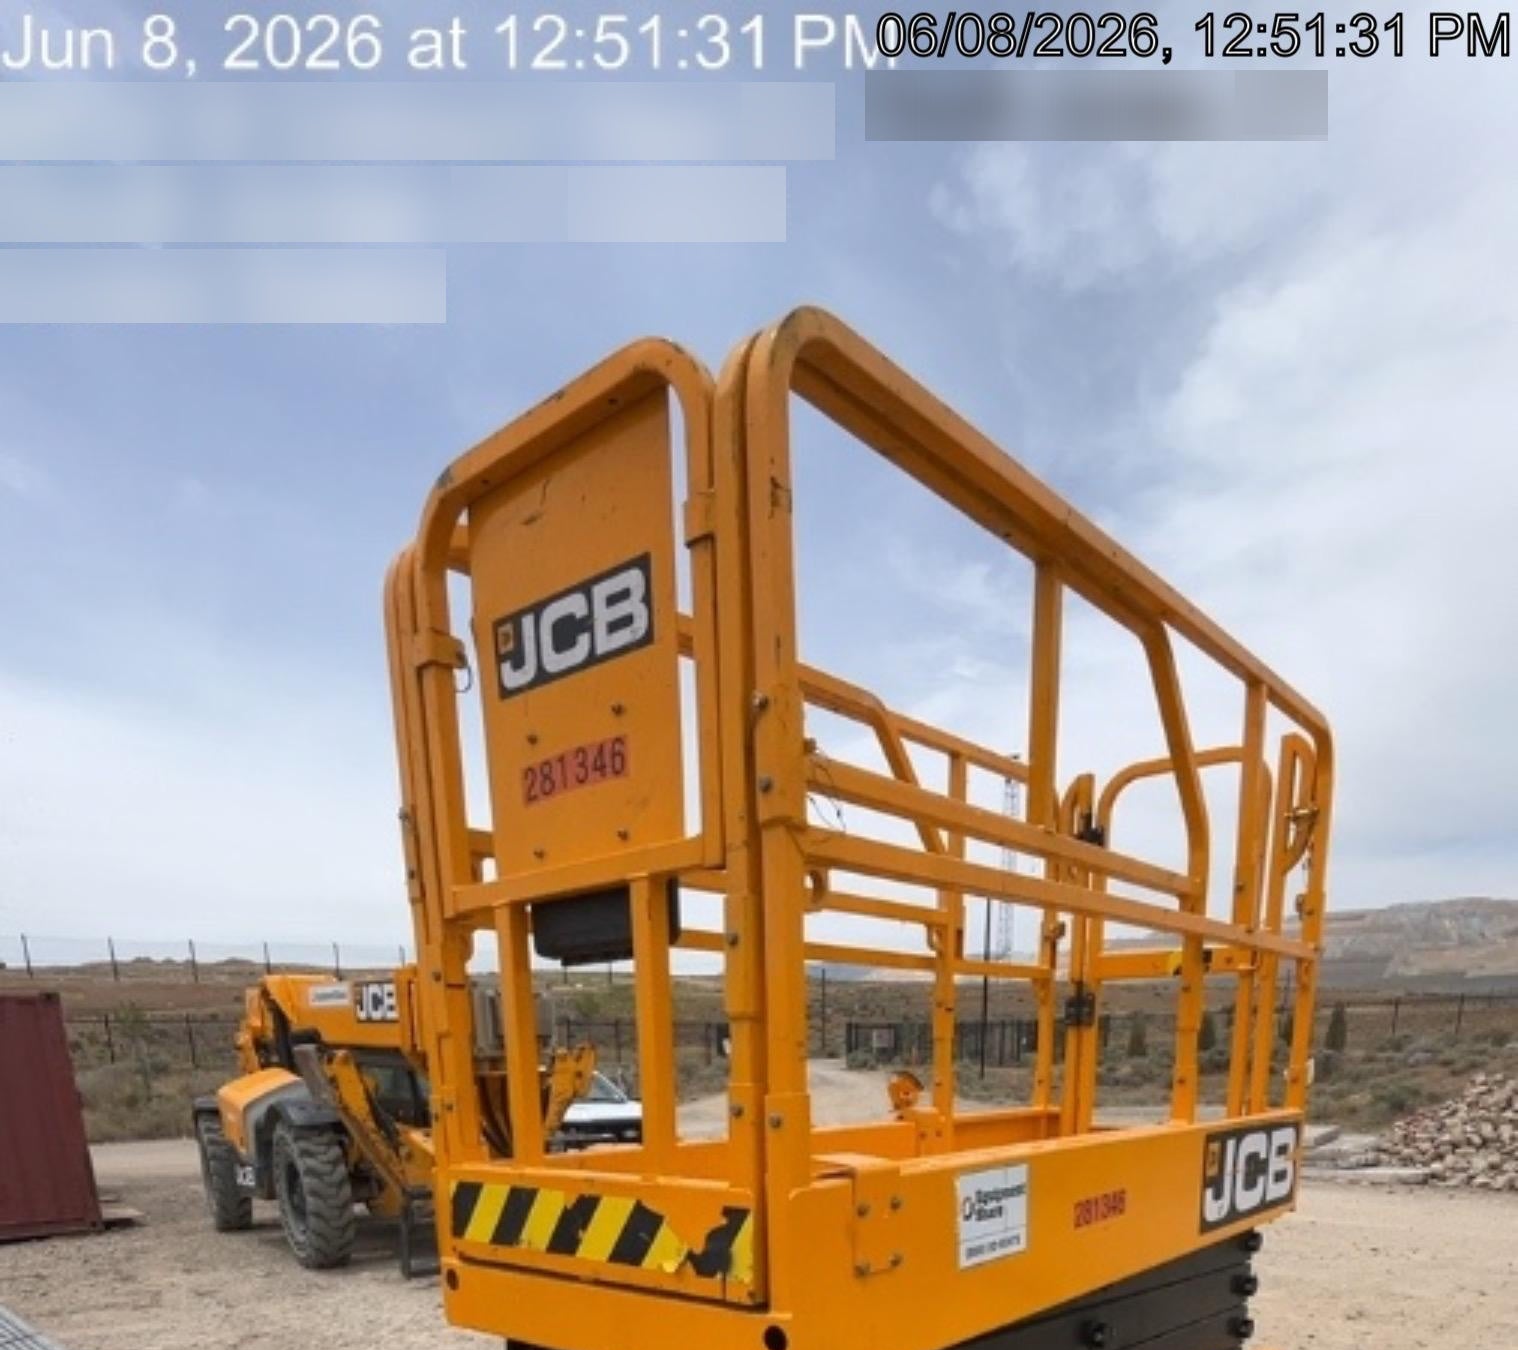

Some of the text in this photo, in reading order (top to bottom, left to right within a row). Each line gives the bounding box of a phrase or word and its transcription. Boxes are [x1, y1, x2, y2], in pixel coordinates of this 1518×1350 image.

[500, 568, 649, 691] JCB
[524, 737, 626, 803] 281346
[355, 983, 399, 1021] JCB
[1203, 1126, 1297, 1222] JCB
